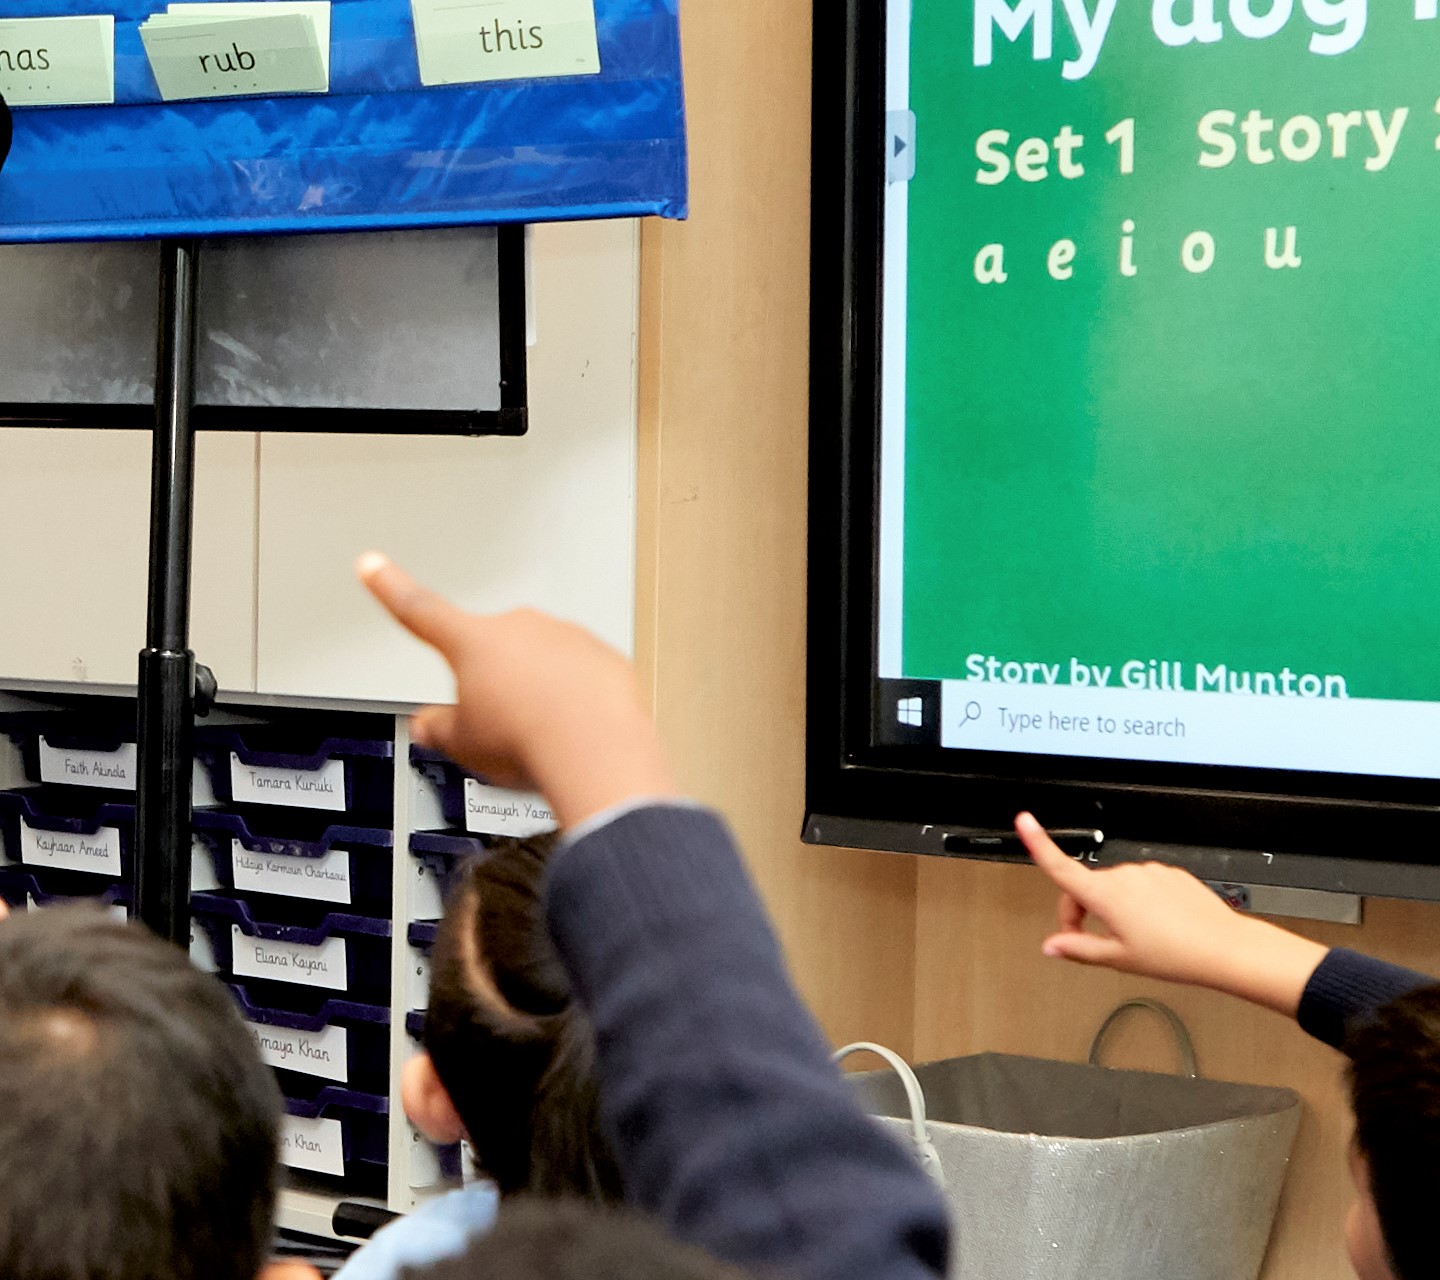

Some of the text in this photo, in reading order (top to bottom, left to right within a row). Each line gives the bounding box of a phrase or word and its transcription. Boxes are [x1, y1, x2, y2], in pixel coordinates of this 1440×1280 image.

[479, 19, 544, 53] this
[199, 42, 256, 73] rub
[973, 126, 1085, 186] Set
[1105, 117, 1136, 175] 1
[1197, 103, 1410, 172] Story
[973, 219, 1302, 284] a e i o u
[965, 653, 1350, 699] Story by Gill Munton
[997, 706, 1187, 738] Type here to search
[64, 759, 89, 775] Faith
[249, 771, 292, 790] Tamara
[467, 798, 519, 821] Sumaiyah
[255, 947, 328, 976] Eliana Kayani
[253, 1029, 331, 1062] Amaya Khan
[294, 1133, 322, 1153] Khan
